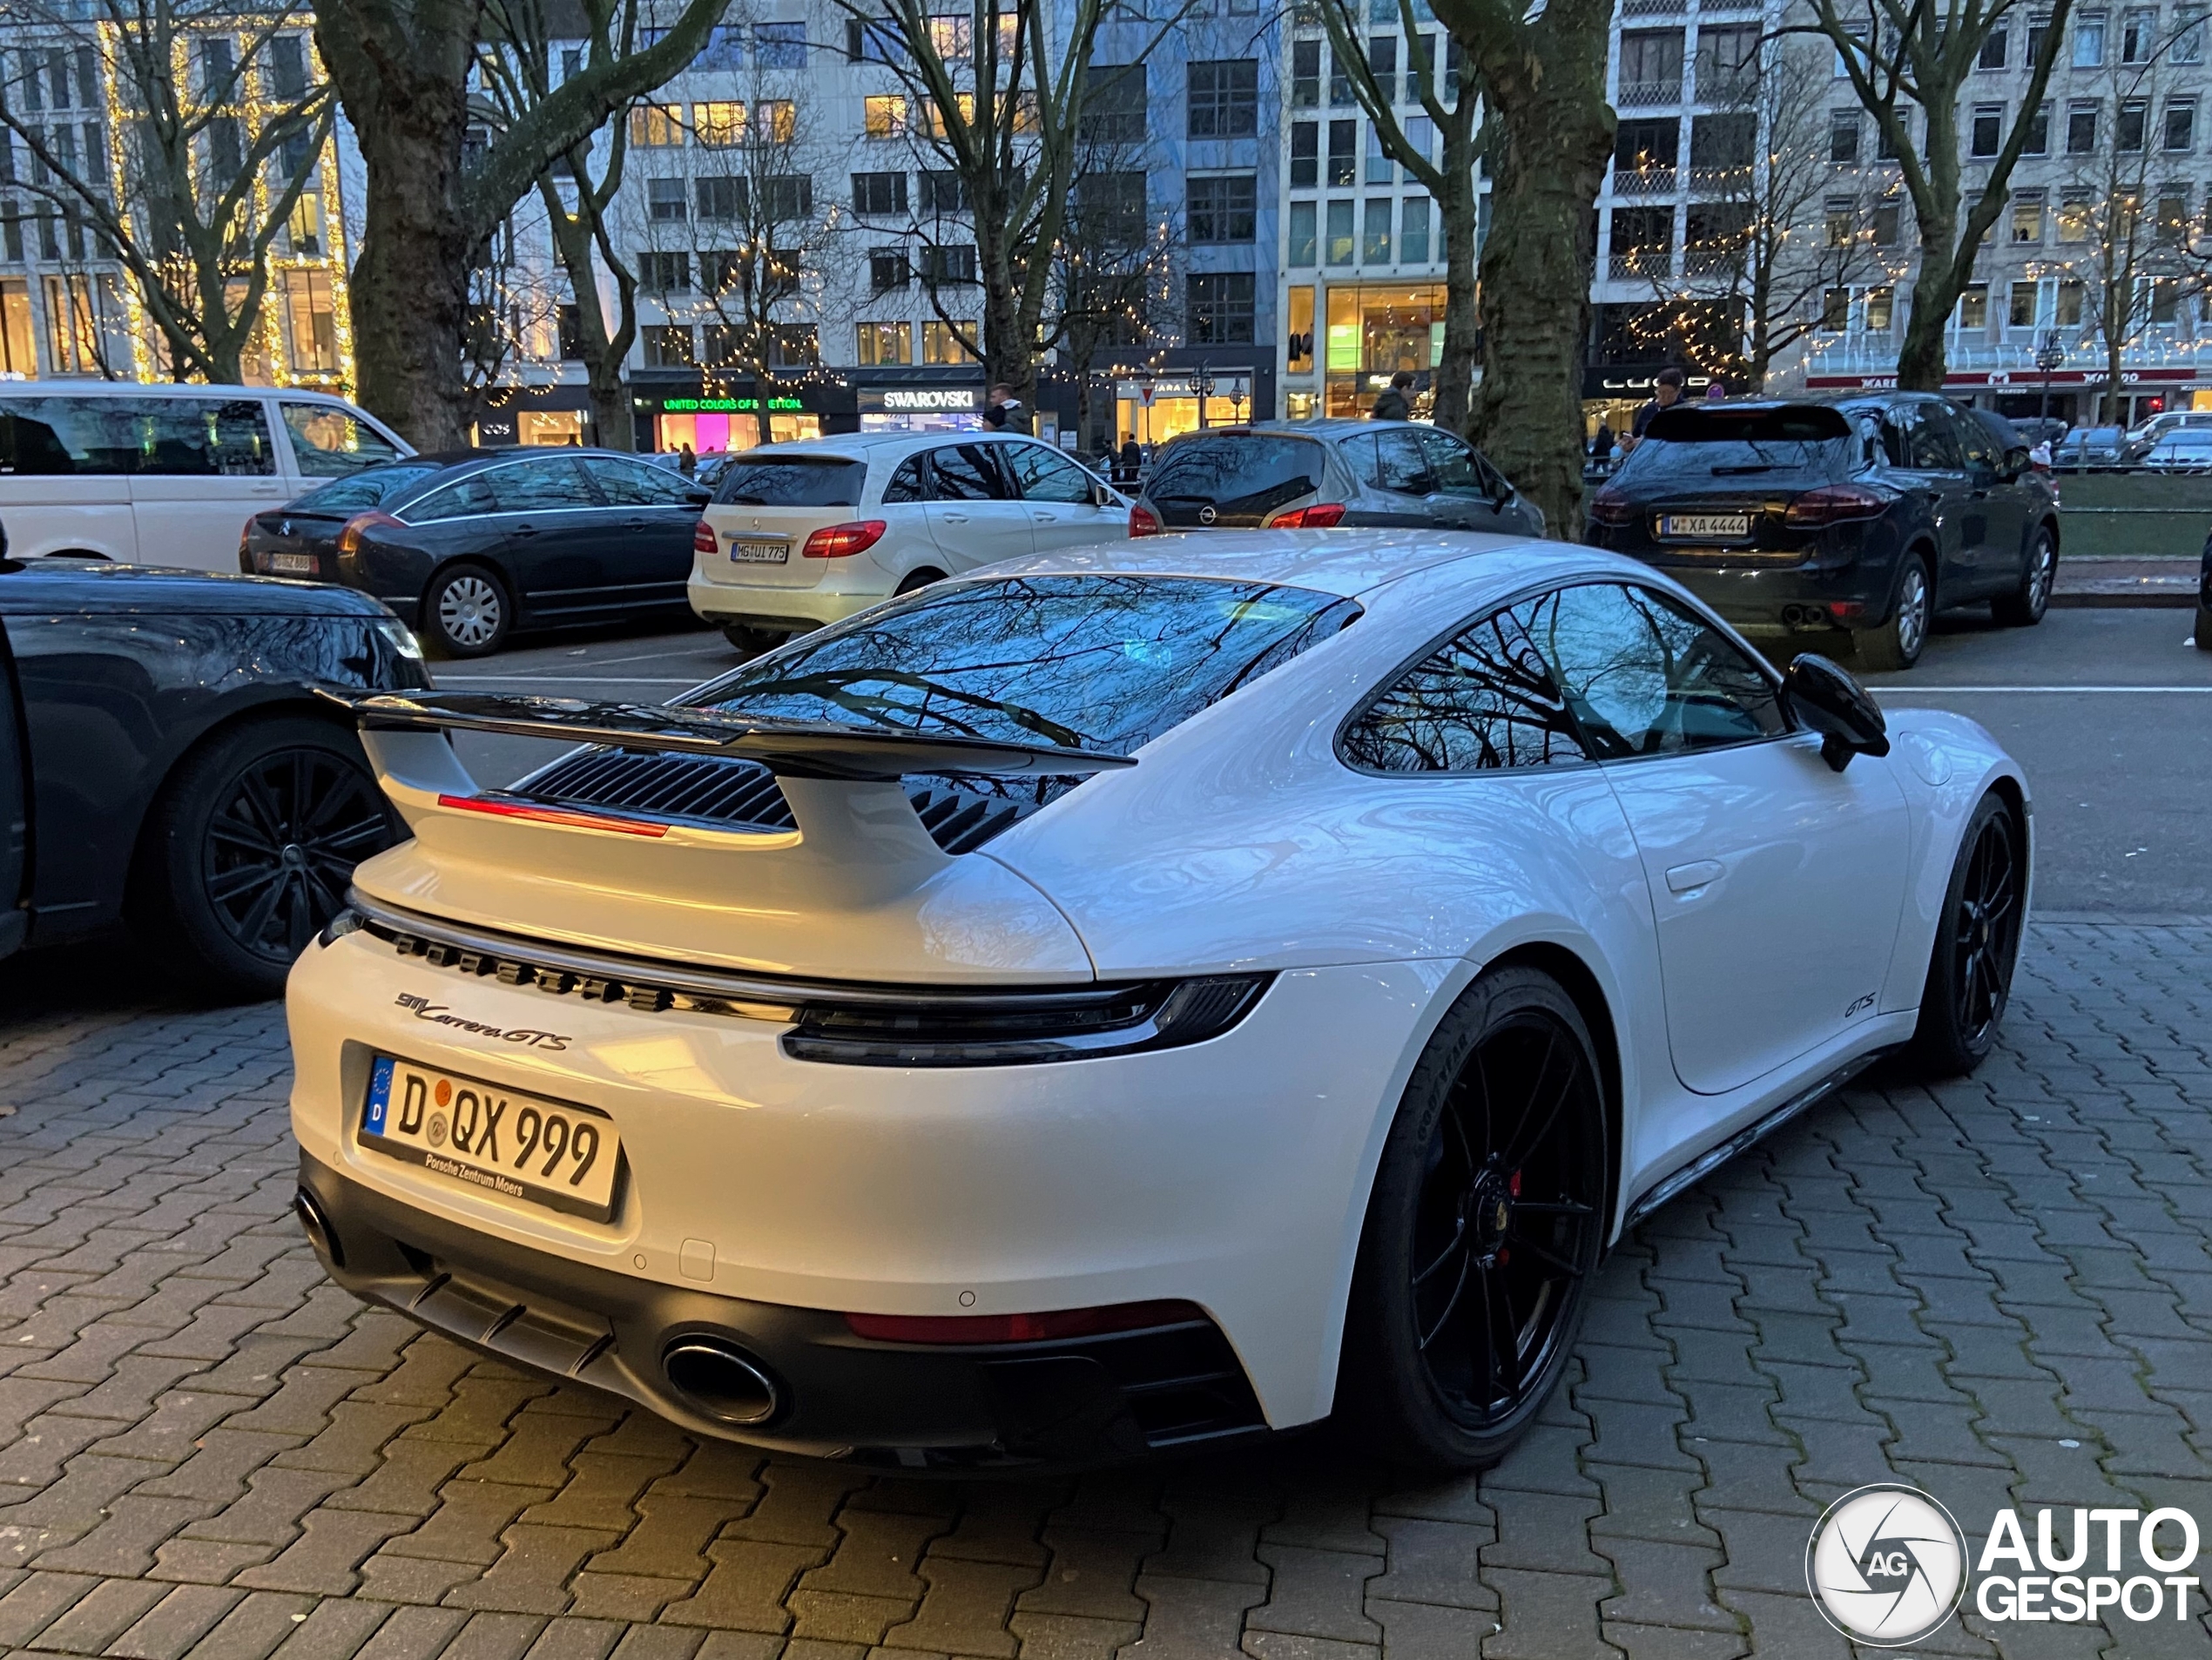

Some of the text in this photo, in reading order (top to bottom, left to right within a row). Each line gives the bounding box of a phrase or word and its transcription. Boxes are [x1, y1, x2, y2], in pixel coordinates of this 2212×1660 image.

[1861, 378, 1897, 388] MARE
[2082, 373, 2139, 383] MADO
[664, 398, 803, 409] UNITED COLORS OF BETTON.
[883, 391, 974, 408] SWAROVSKI
[1671, 518, 1745, 532] W XA 4444
[737, 545, 749, 557] MG
[768, 546, 785, 559] 775
[1844, 991, 1877, 1019] GTS
[395, 992, 573, 1051] 911 Carrera GTS
[372, 1103, 382, 1122] D
[398, 1073, 601, 1186] D QX 999
[426, 1154, 523, 1198] Porsche Zentrum Moers
